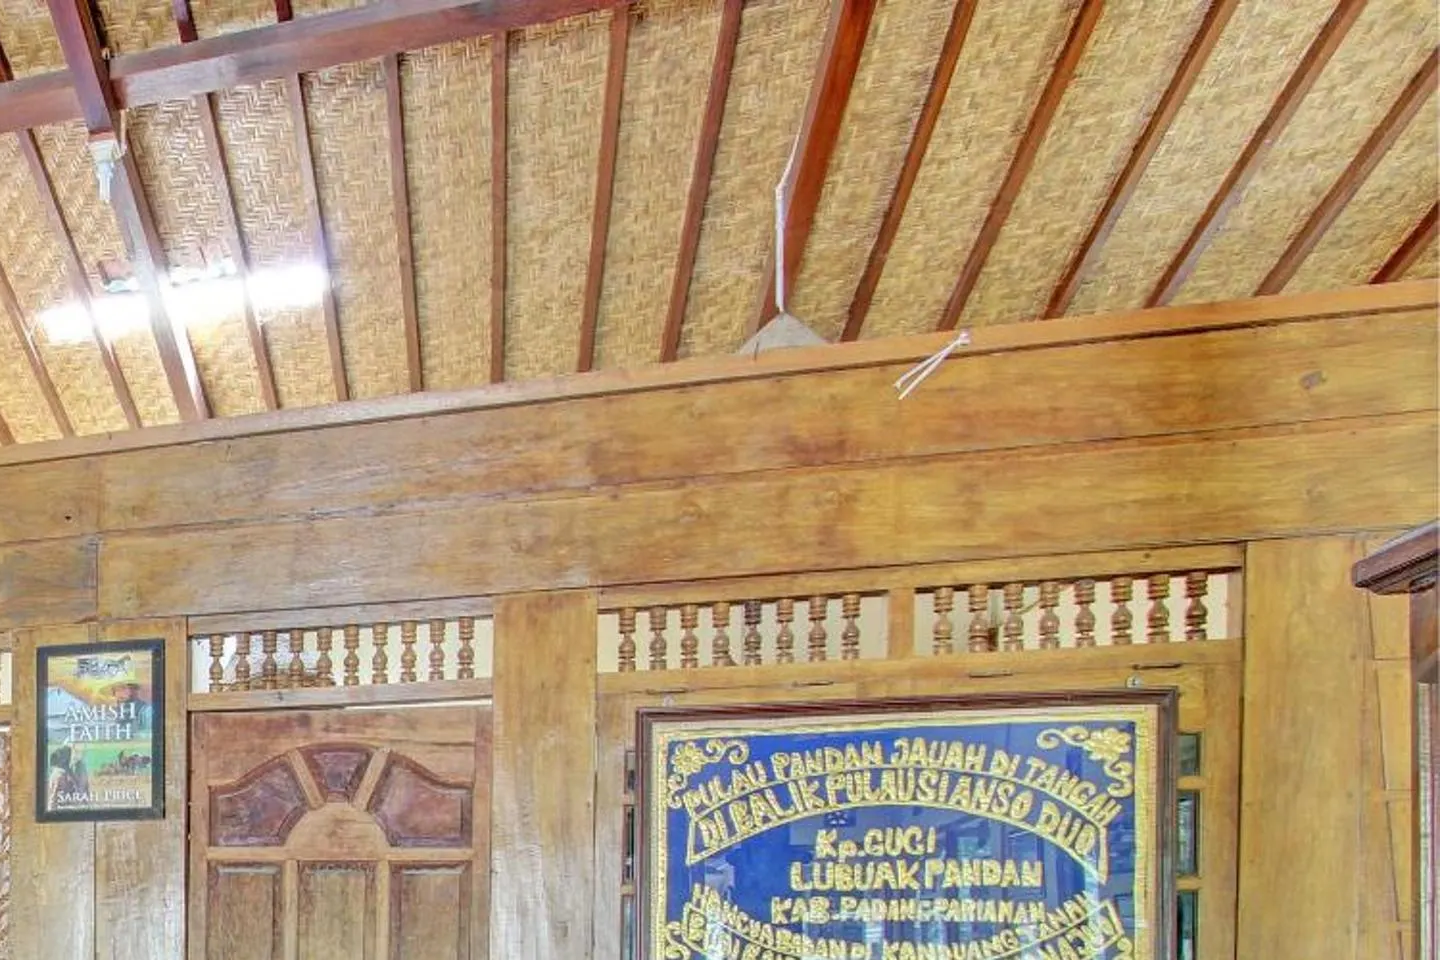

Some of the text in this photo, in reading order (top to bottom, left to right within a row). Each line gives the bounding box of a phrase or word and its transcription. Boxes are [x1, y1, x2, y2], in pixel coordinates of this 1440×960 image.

[68, 722, 133, 742] FAITH
[683, 760, 767, 816] PULAU
[770, 740, 884, 781] PANDAN
[891, 736, 987, 770] JAUAH
[990, 750, 1021, 778] DI
[698, 810, 729, 850] DI
[729, 779, 825, 835] BALIK
[825, 767, 915, 807] PULAU
[948, 774, 1034, 820] ANSO
[1036, 800, 1096, 856] DUO
[790, 859, 1043, 892] LUBUAK PANDAN
